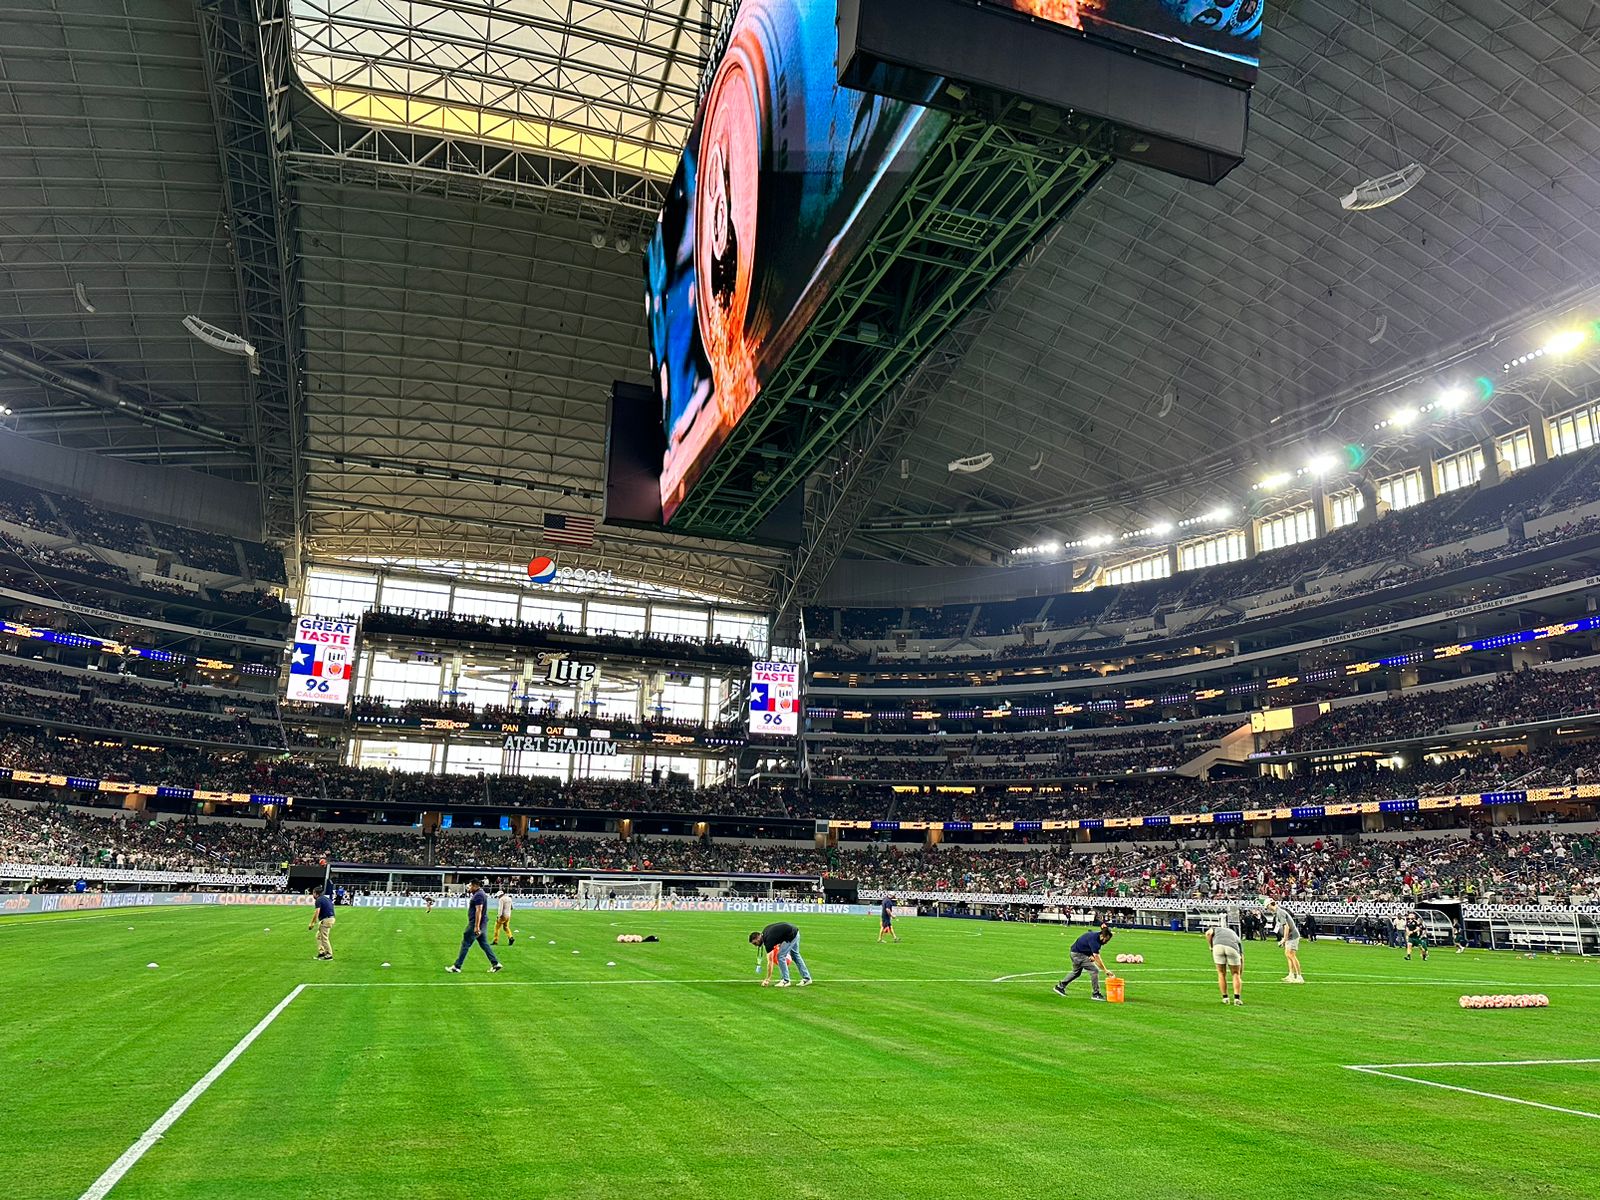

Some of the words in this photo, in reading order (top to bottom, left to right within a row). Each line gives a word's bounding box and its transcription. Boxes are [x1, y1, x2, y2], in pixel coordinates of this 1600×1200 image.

[561, 567, 613, 585] pepsi
[72, 605, 90, 613] DREW
[91, 609, 120, 619] PEARSON
[1453, 604, 1482, 616] CHARLES
[1482, 600, 1503, 609] HALEY
[300, 619, 354, 634] GREAT
[300, 630, 350, 645] TASTE
[1329, 634, 1351, 643] DARREN
[1352, 628, 1380, 637] WOODSON
[546, 659, 596, 685] Lite
[754, 663, 797, 673] GREAT
[755, 672, 795, 682] TASTE
[306, 678, 330, 692] 96
[296, 690, 340, 700] CALORIES
[764, 713, 783, 725] 96
[501, 724, 519, 732] PAN
[546, 726, 563, 735] QAT
[503, 735, 544, 751] AT&T
[548, 739, 617, 756] STADIUM
[42, 895, 59, 911] VISIT
[202, 893, 218, 904] VISIT
[362, 896, 391, 907] THE
[727, 901, 749, 912] FOR
[752, 902, 773, 912] THE
[776, 903, 815, 913] LATEST
[818, 904, 850, 914] NEWS
